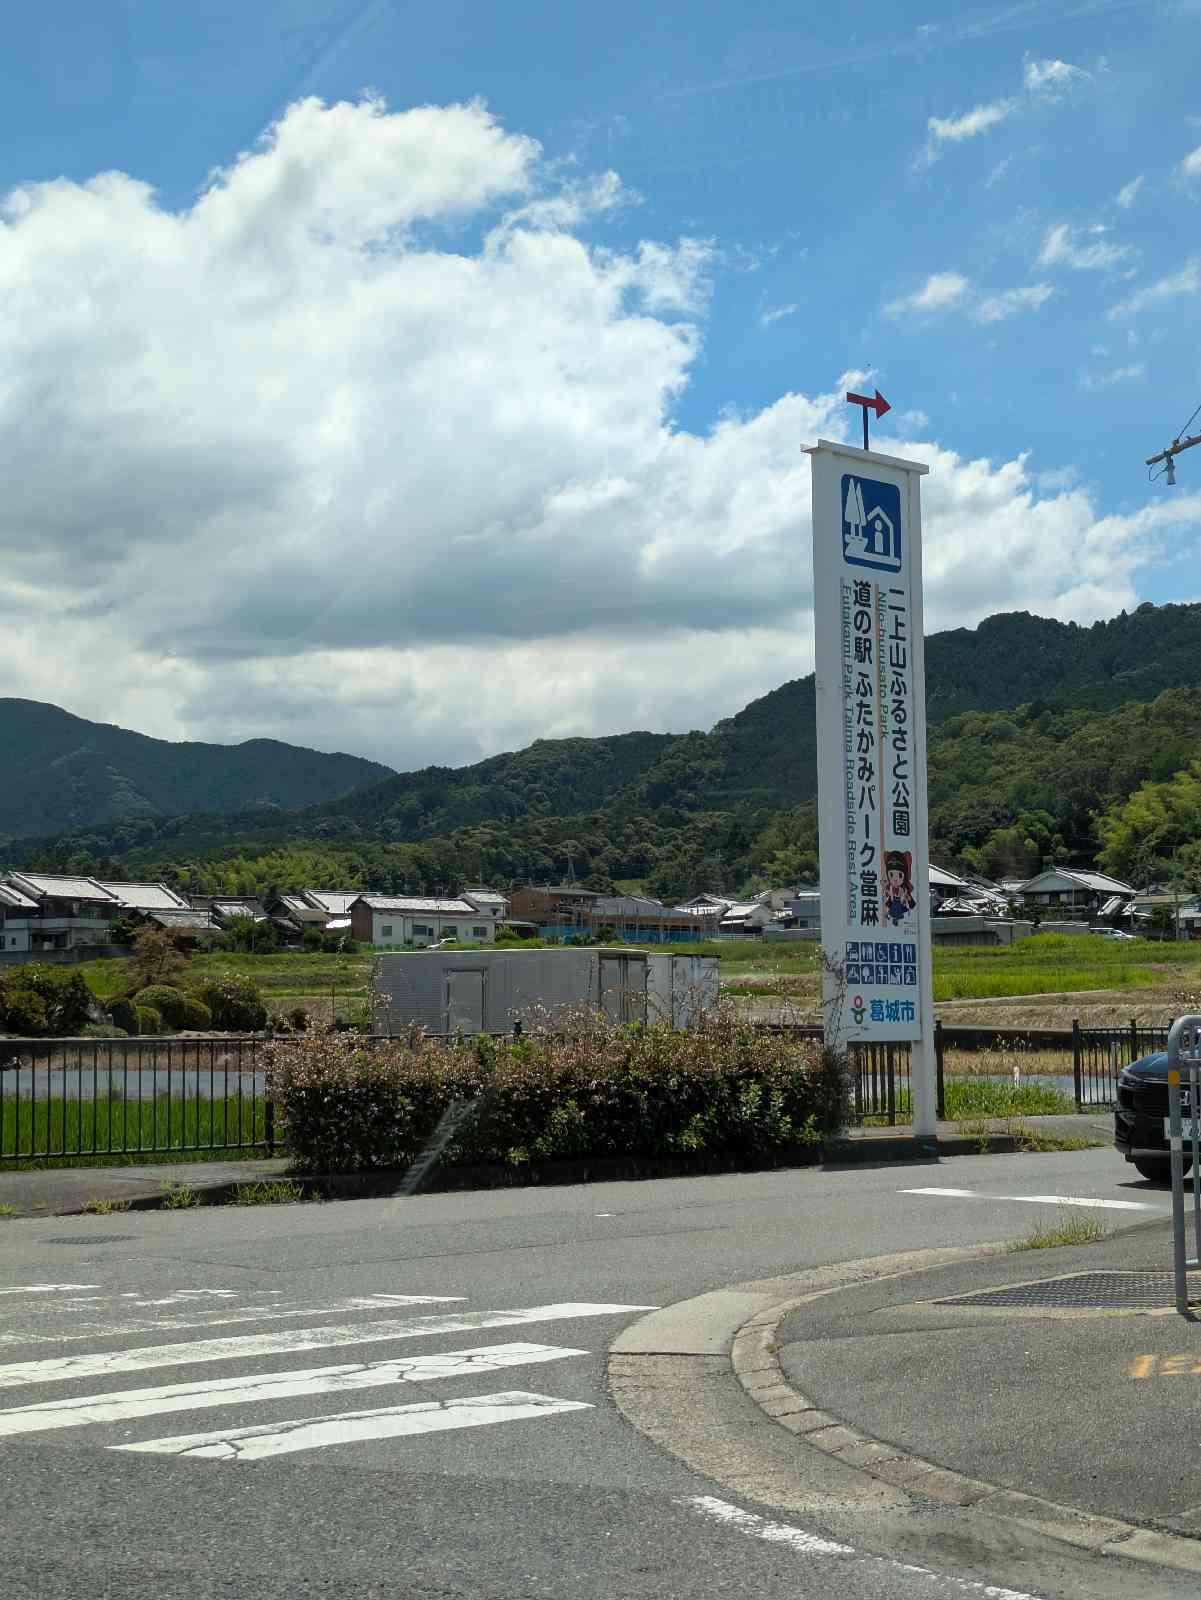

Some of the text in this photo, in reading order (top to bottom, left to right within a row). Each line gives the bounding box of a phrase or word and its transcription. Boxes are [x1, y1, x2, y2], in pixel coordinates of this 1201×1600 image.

[853, 579, 872, 664] 道の駅
[842, 585, 858, 918] Futakami Park Taima Roadside Rest Area
[880, 704, 889, 739] Park
[888, 588, 910, 836] 二上山ふるさと公園
[870, 998, 915, 1022] 葛城市
